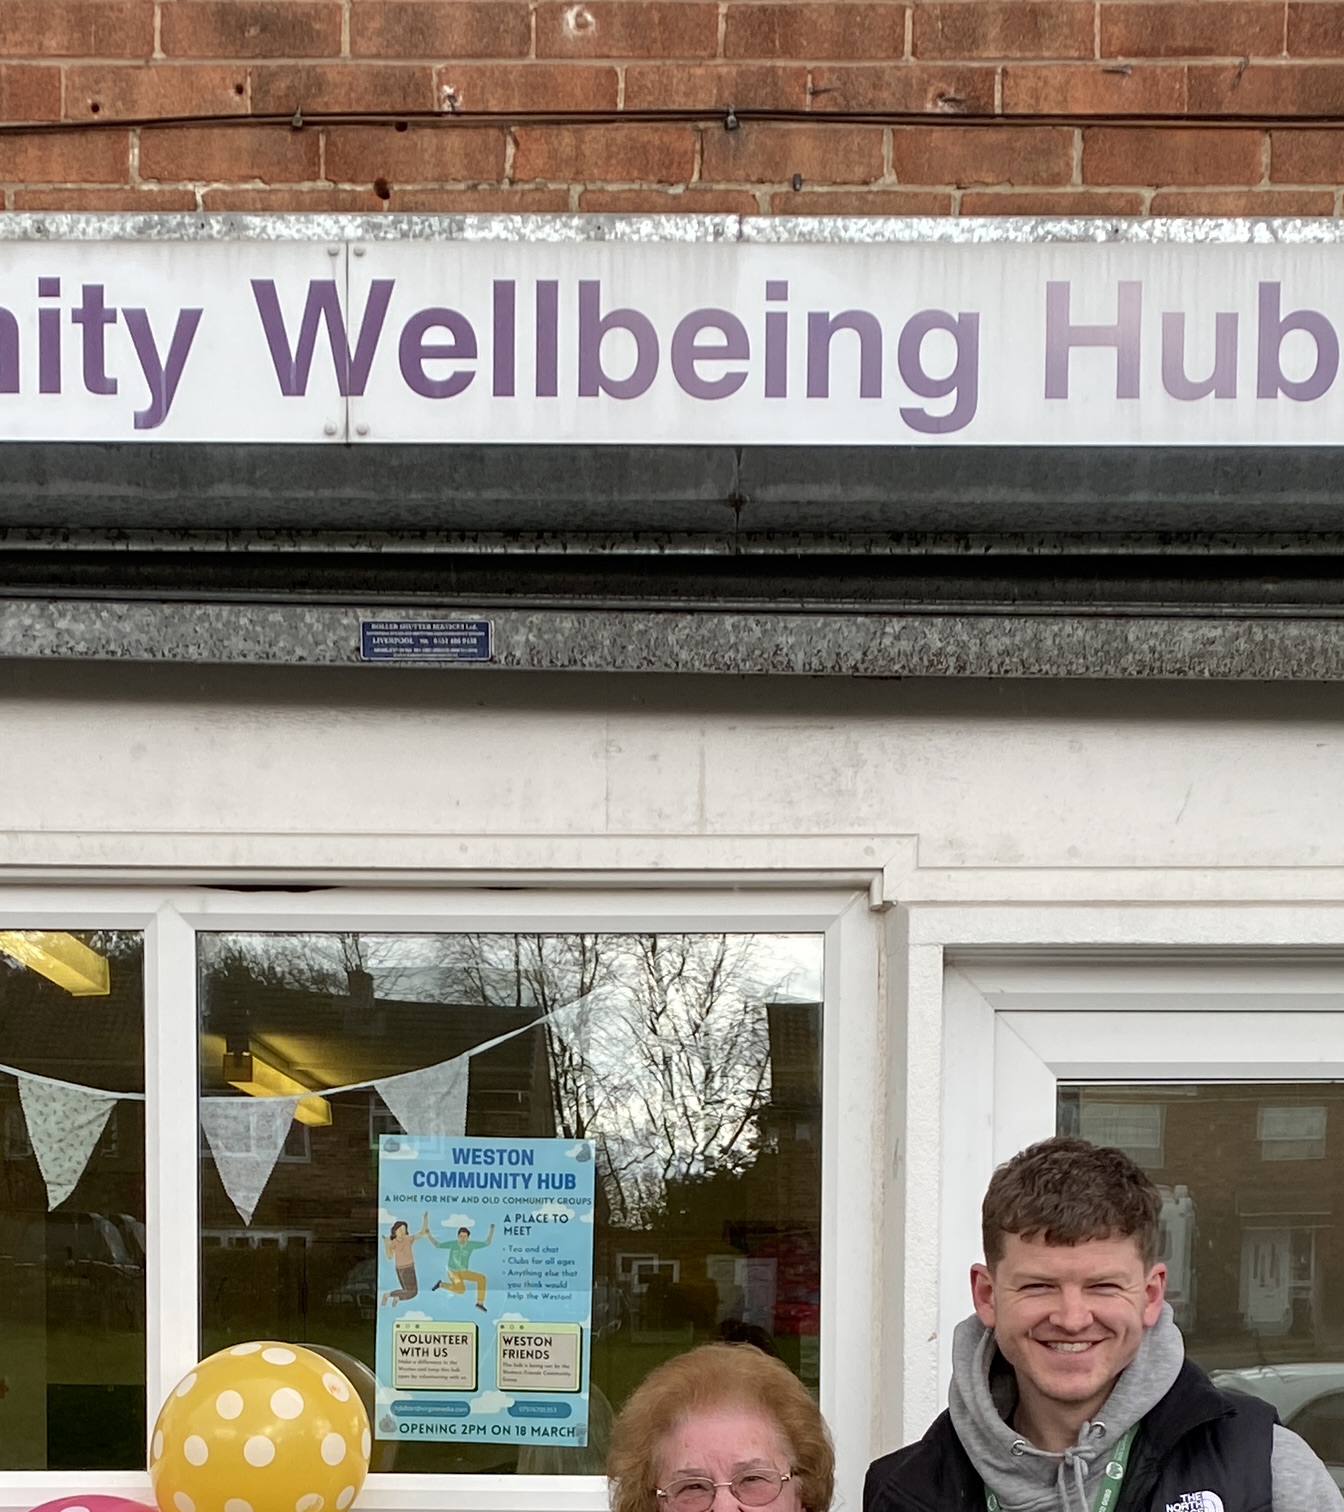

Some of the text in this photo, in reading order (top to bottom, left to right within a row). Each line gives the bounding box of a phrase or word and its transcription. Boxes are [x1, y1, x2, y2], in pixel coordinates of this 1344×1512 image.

[250, 278, 980, 434] Wellbeing
[1044, 280, 1341, 402] Hub
[452, 1147, 534, 1165] WESTON
[413, 1170, 576, 1190] COMMUNITY HUB
[393, 1195, 418, 1203] HOME
[420, 1195, 437, 1203] FOR
[440, 1196, 459, 1204] NEW
[461, 1196, 480, 1204] AND
[502, 1197, 554, 1205] COMMUNITY
[557, 1197, 592, 1205] GROUPS
[504, 1214, 568, 1223] A PLACE TO
[504, 1226, 532, 1235] MEET
[508, 1245, 522, 1253] Tea
[525, 1245, 539, 1253] and
[532, 1257, 543, 1265] for
[545, 1257, 554, 1265] all
[508, 1269, 542, 1278] Anything
[399, 1334, 468, 1345] VOLUNTEER
[503, 1336, 552, 1347] WESTON
[400, 1347, 448, 1357] WITH US
[503, 1350, 549, 1360] FRIENDS
[399, 1423, 575, 1437] OPENING 2PM ON 18 MARCH
[1180, 1492, 1202, 1502] THE
[1166, 1501, 1203, 1512] NORTH
